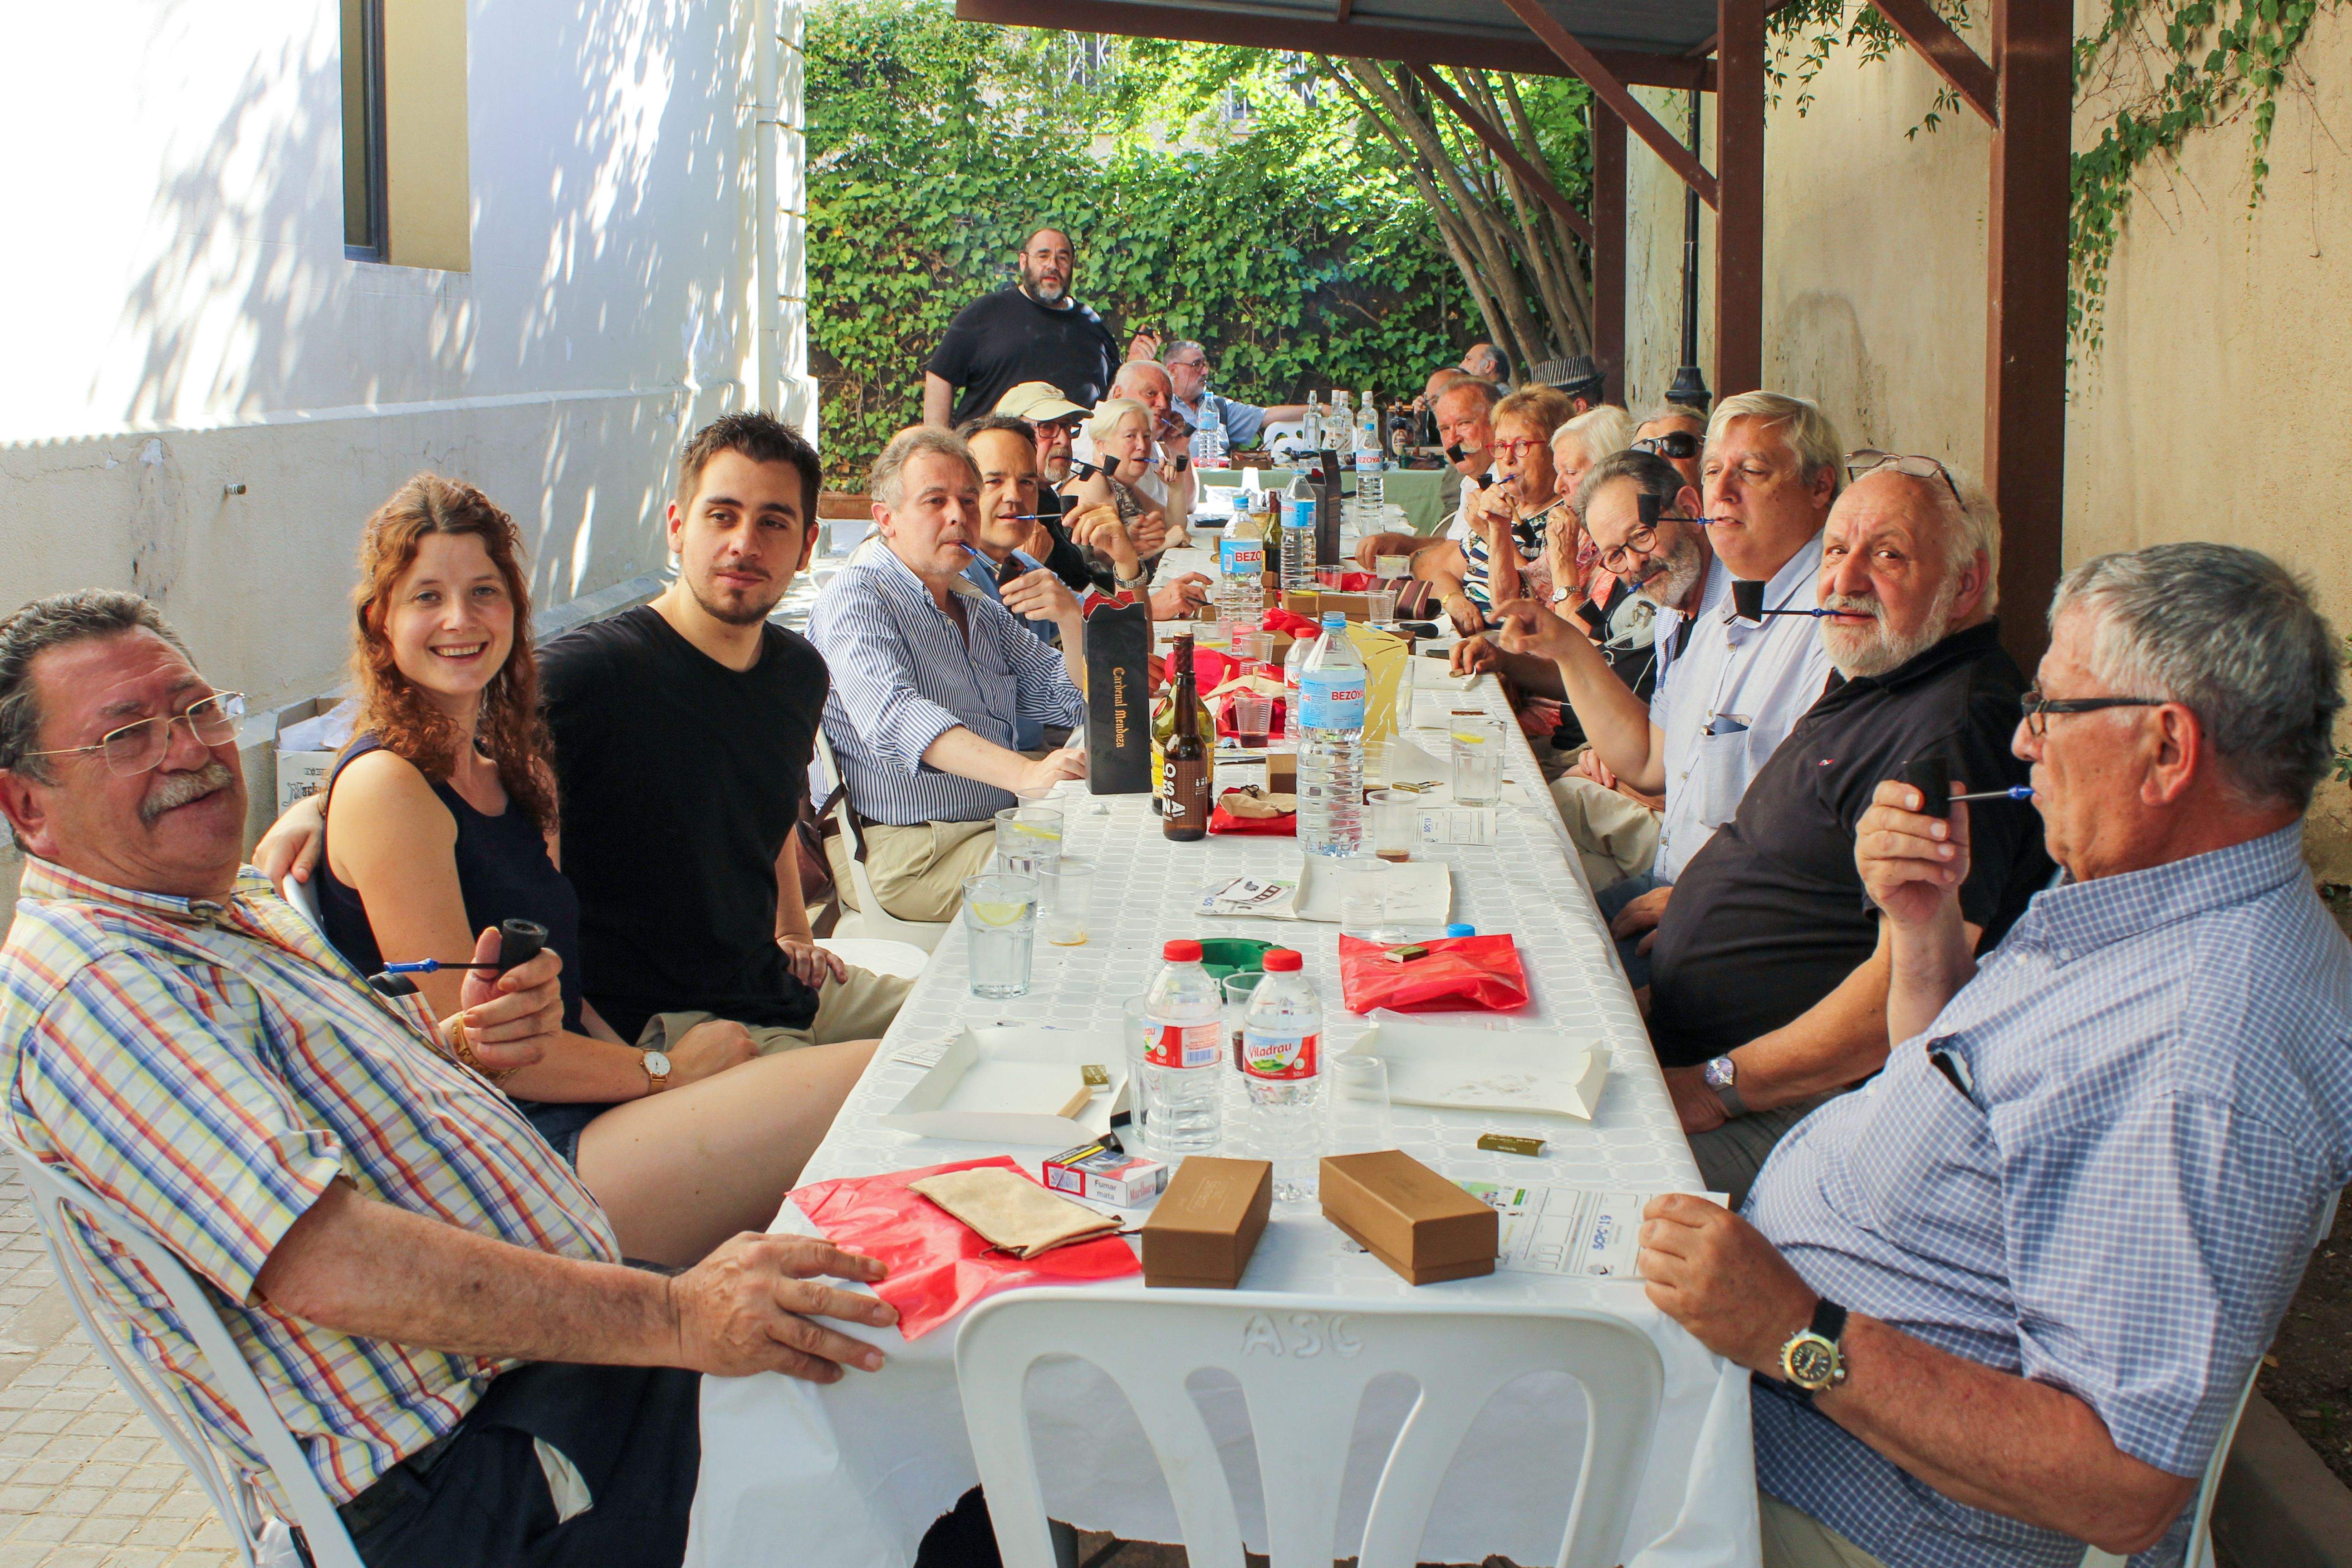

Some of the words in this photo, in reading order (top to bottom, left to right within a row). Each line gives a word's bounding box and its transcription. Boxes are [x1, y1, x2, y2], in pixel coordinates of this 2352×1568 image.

[1235, 551, 1262, 562] BEZO
[1113, 666, 1128, 707] Cardenal
[1114, 709, 1130, 748] Mendoza
[1249, 1043, 1293, 1059] Viladrau
[1094, 1179, 1117, 1191] Fumar
[1097, 1191, 1115, 1201] mata
